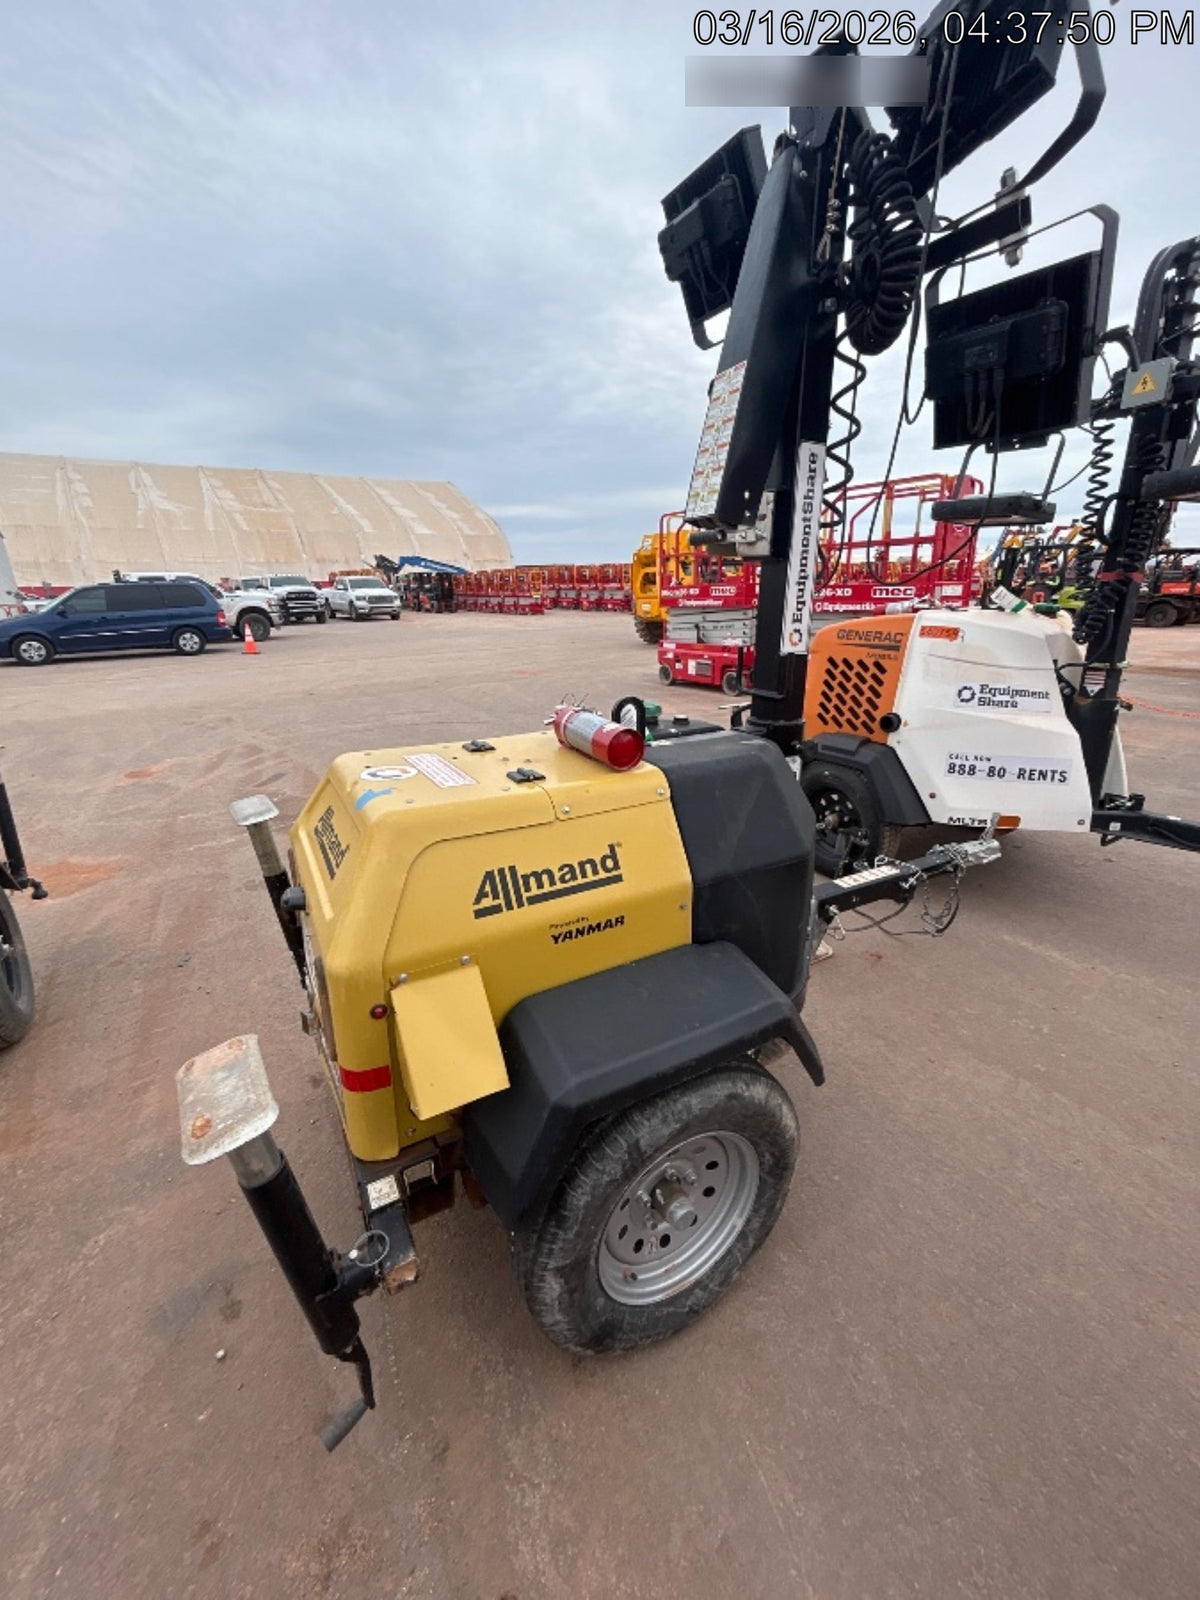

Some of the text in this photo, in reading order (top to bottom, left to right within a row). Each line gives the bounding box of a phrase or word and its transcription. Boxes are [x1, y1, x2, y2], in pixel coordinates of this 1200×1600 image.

[837, 629, 904, 643] GENERAC
[979, 684, 1050, 700] Equipment
[978, 697, 1018, 708] Share
[473, 843, 621, 912] Allmand
[551, 915, 625, 945] YANMAR
